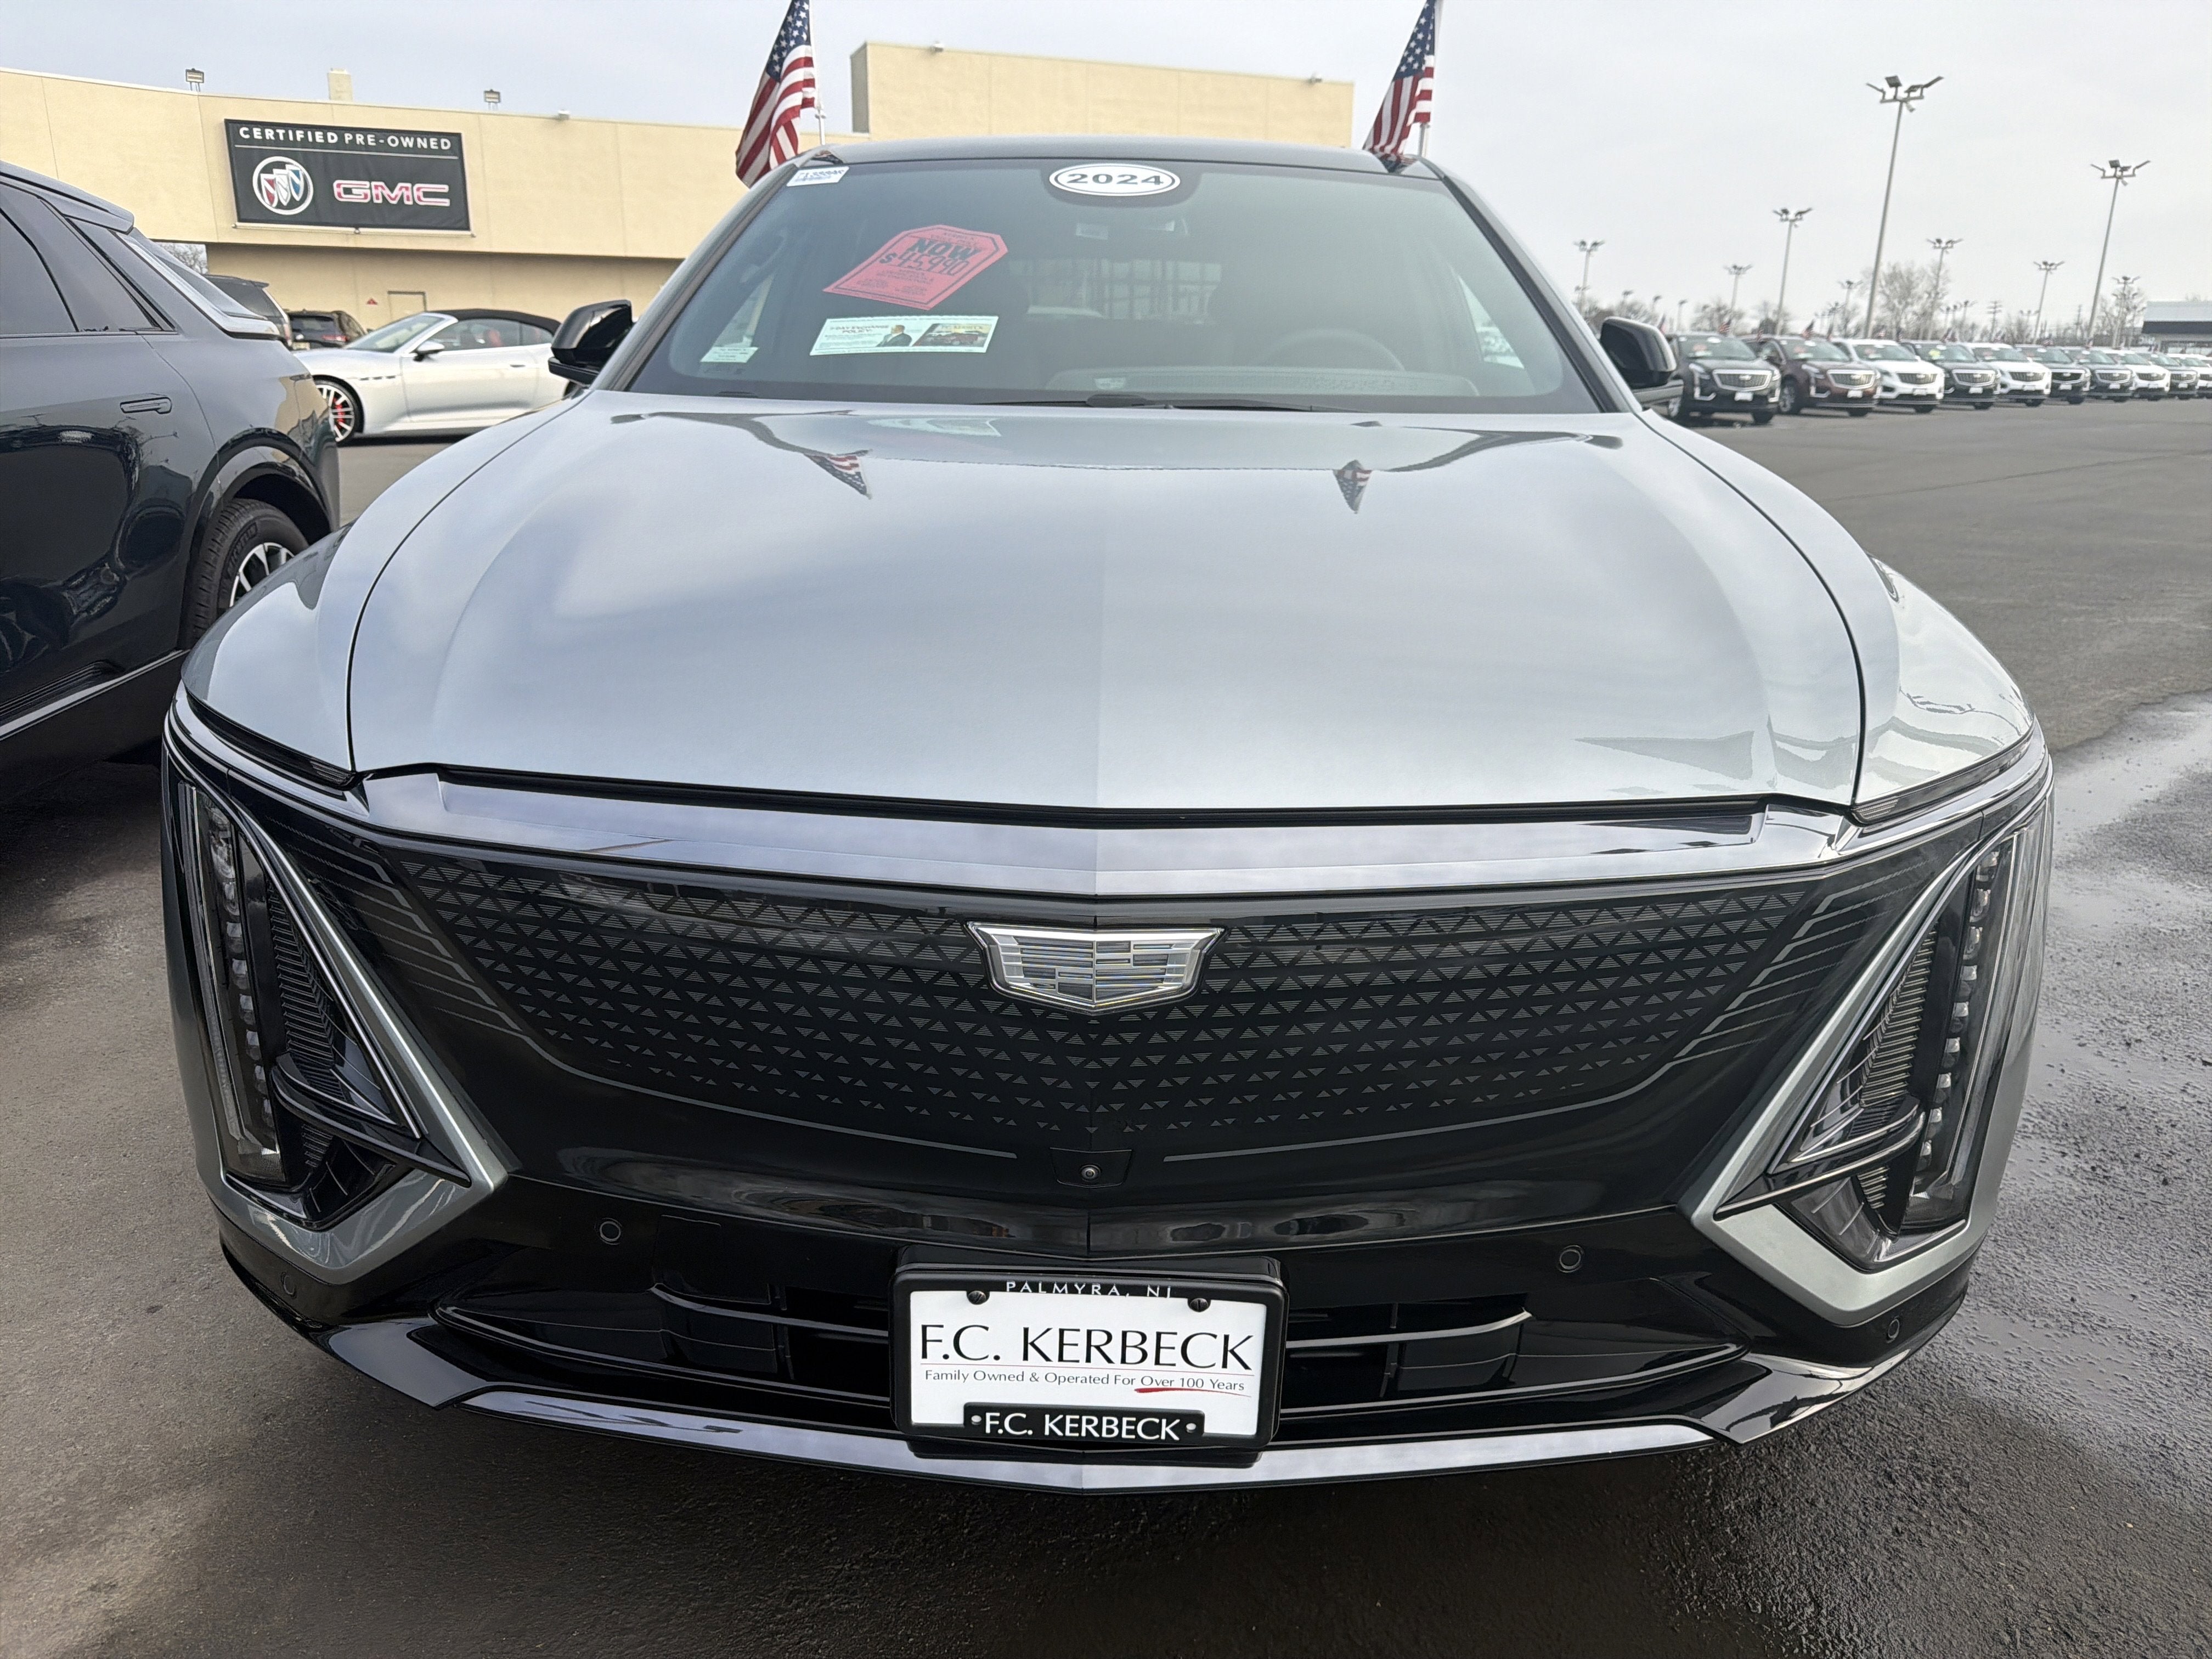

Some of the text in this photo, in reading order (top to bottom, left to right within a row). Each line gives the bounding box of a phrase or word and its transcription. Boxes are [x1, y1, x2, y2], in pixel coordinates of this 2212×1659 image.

[239, 126, 452, 150] CERTIFIED PRE-OWNED
[1066, 173, 1164, 185] 2024
[332, 179, 450, 207] GMC
[907, 238, 981, 261] NOW
[1006, 1281, 1130, 1297] PALMYRA,
[921, 1324, 1254, 1370] F.C. KERBECK
[925, 1370, 1244, 1391] Family Owned & Operated For Over 100 Years
[985, 1412, 1181, 1441] F.C. KERBECK
